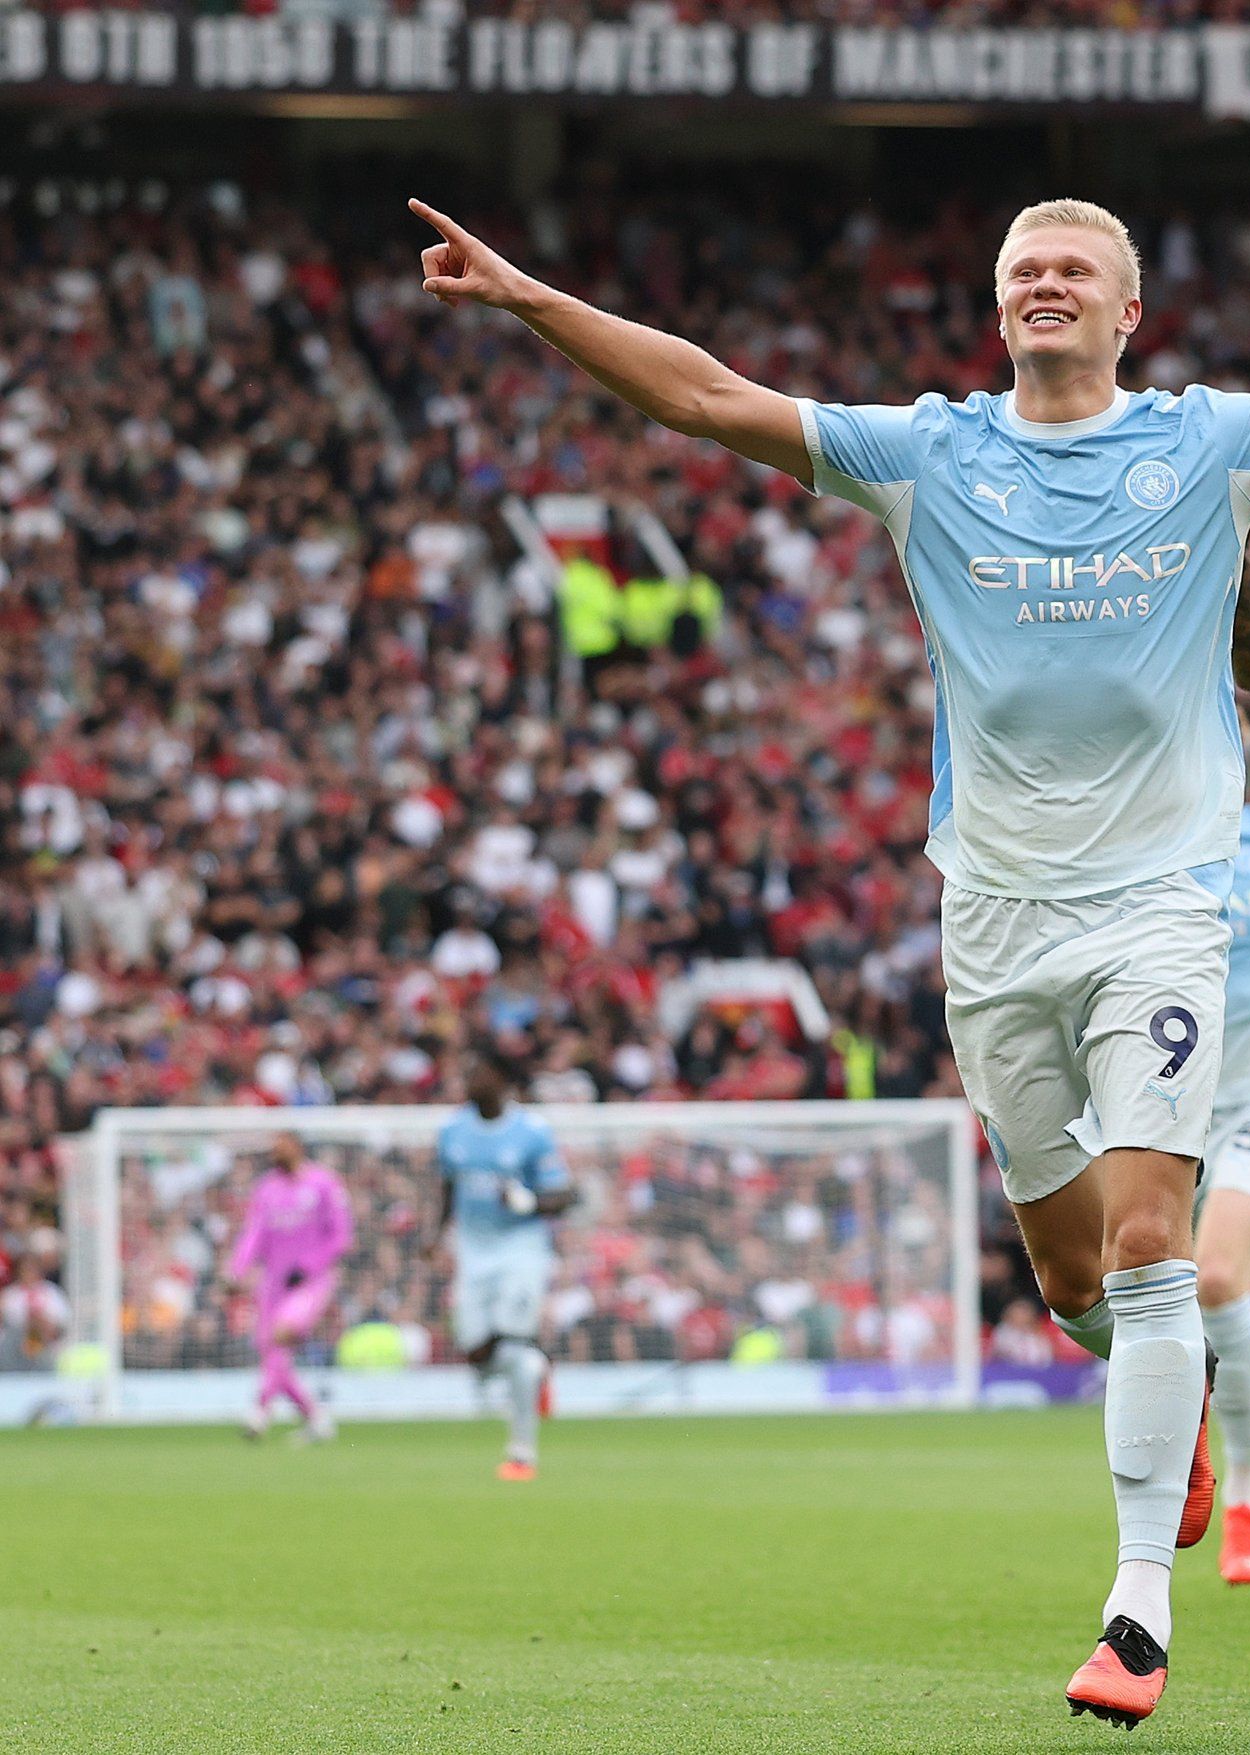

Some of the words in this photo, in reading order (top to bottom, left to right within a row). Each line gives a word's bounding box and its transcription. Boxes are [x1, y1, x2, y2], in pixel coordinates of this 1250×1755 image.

[353, 18, 457, 91] THE
[748, 21, 818, 97] OF
[968, 542, 1191, 590] ETIHAD
[1016, 594, 1150, 623] AIRWAYS
[1149, 1006, 1199, 1079] 9
